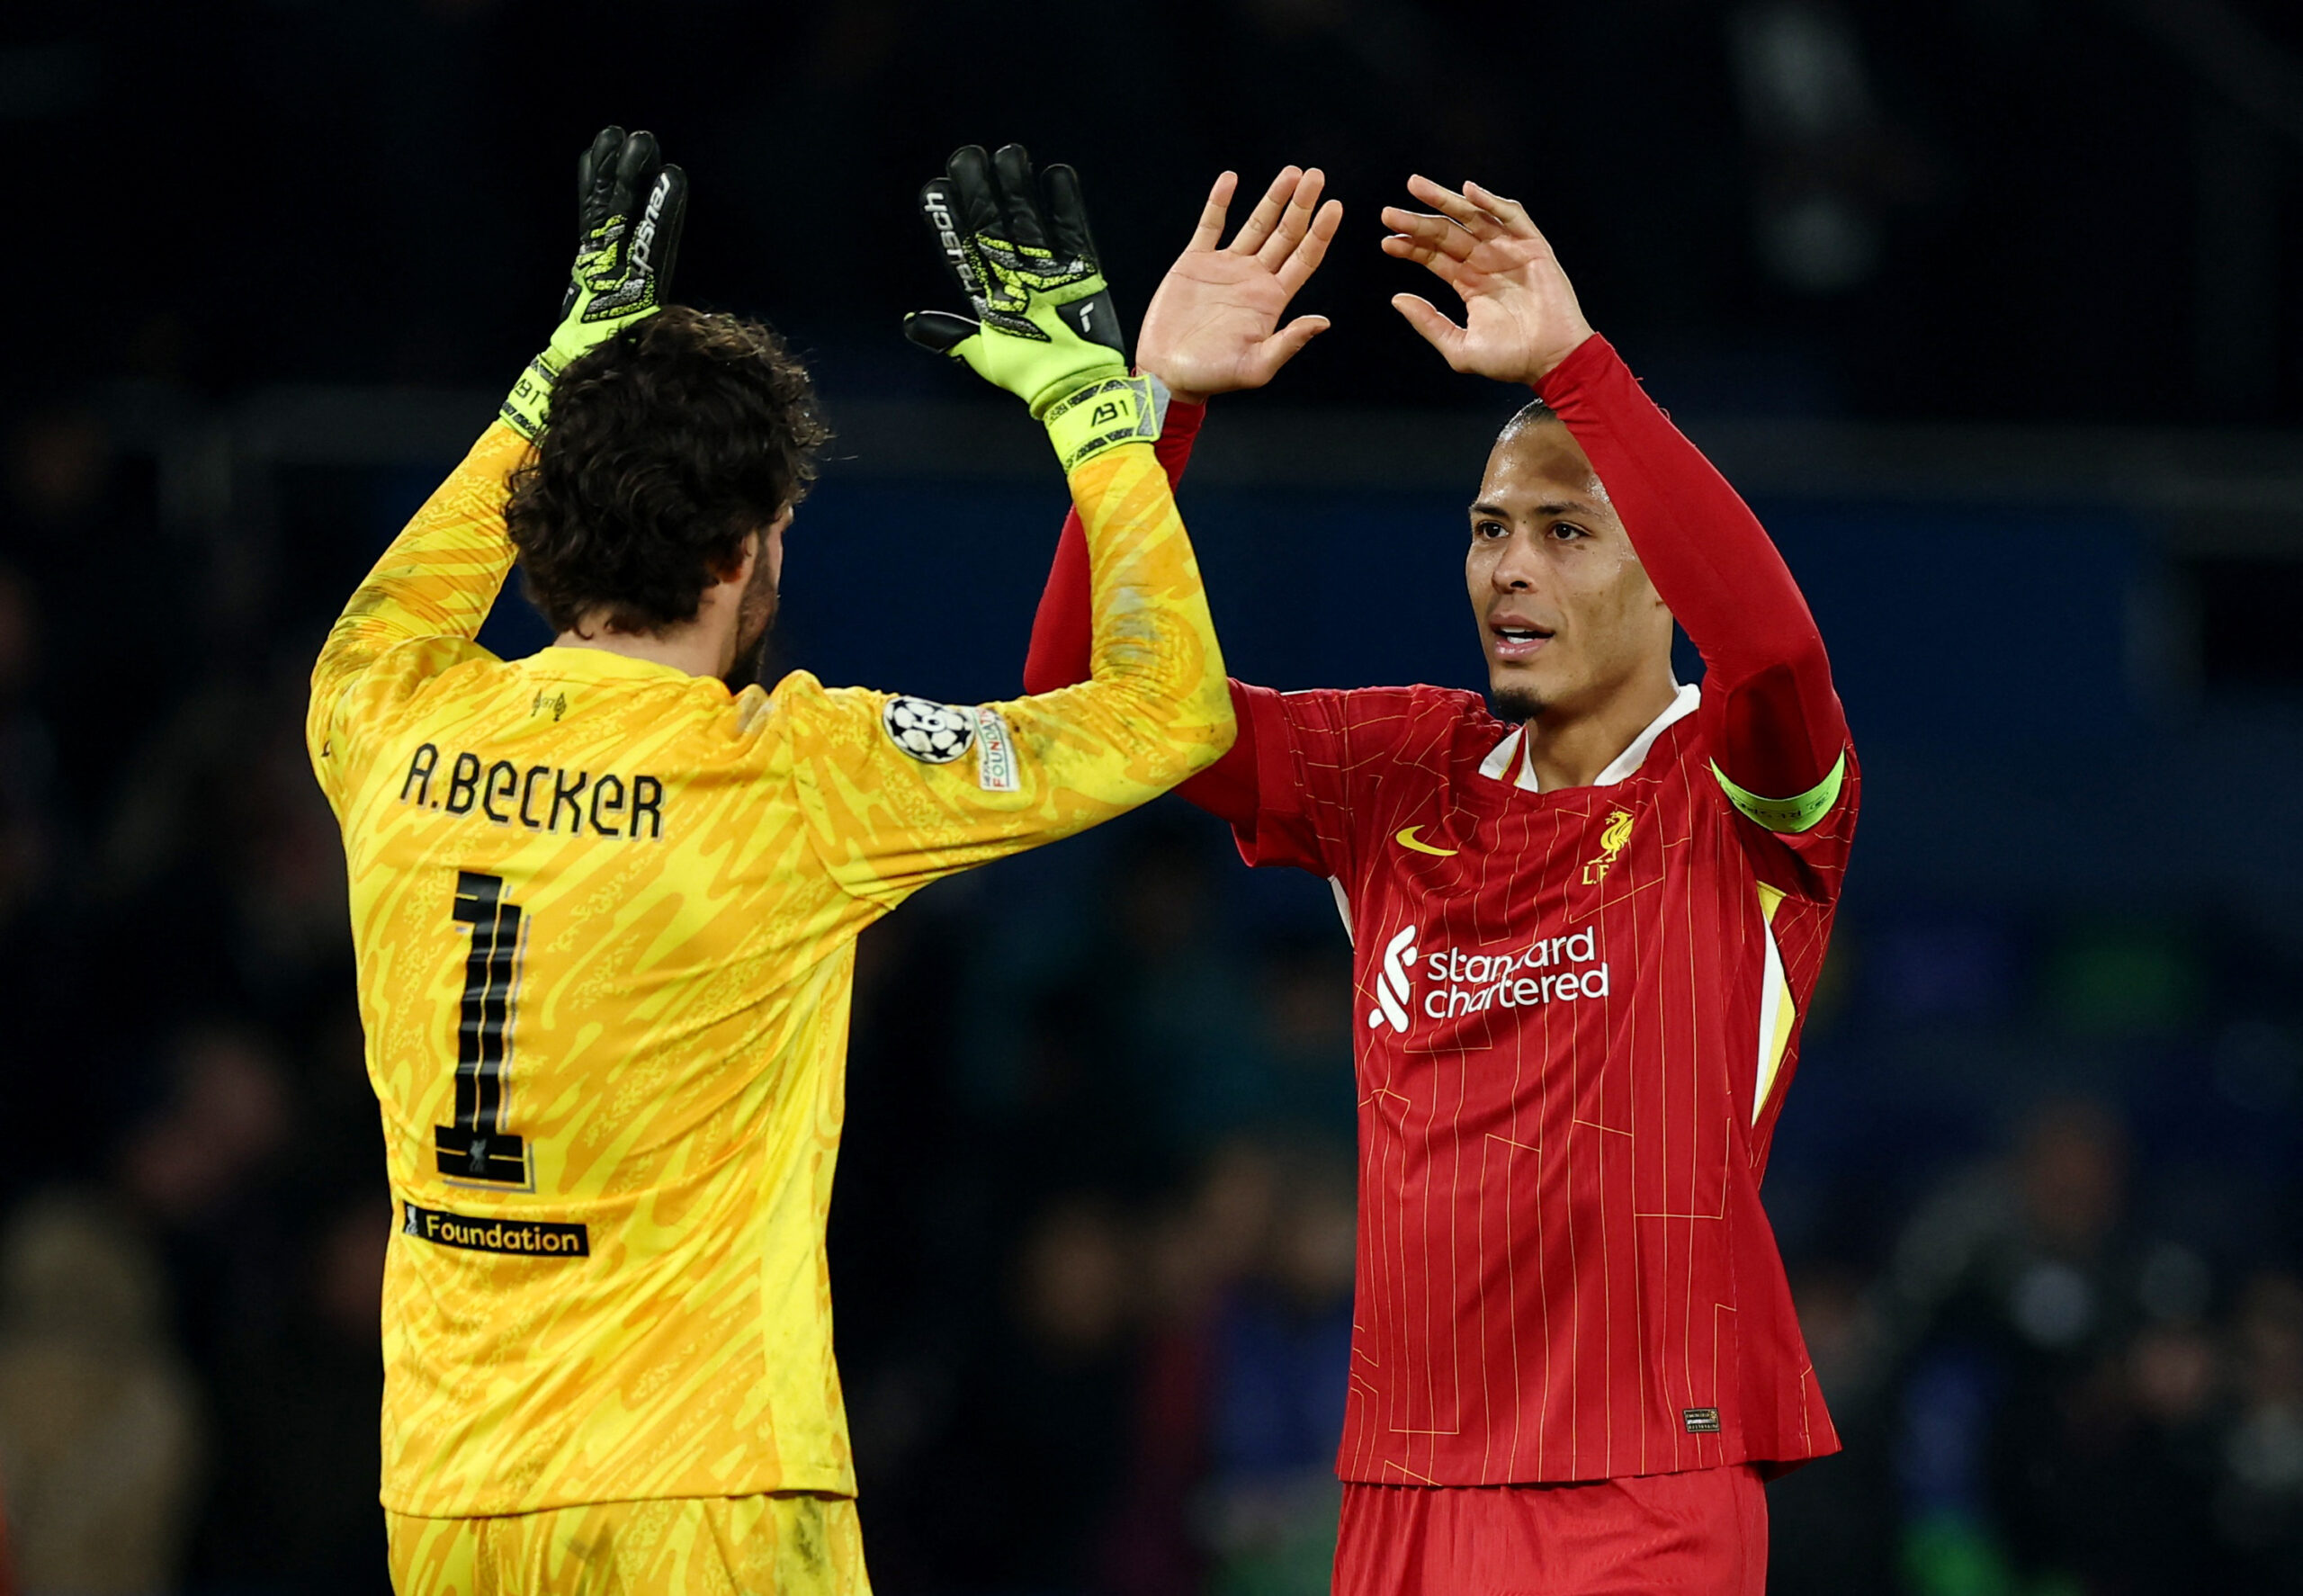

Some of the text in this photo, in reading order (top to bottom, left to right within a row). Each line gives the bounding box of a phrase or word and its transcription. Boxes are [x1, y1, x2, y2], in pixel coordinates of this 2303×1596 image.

[632, 172, 671, 277] reusch
[923, 192, 983, 292] reusch
[434, 870, 531, 1188] 1
[1424, 961, 1610, 1019] chartered
[425, 1215, 580, 1252] Foundation
